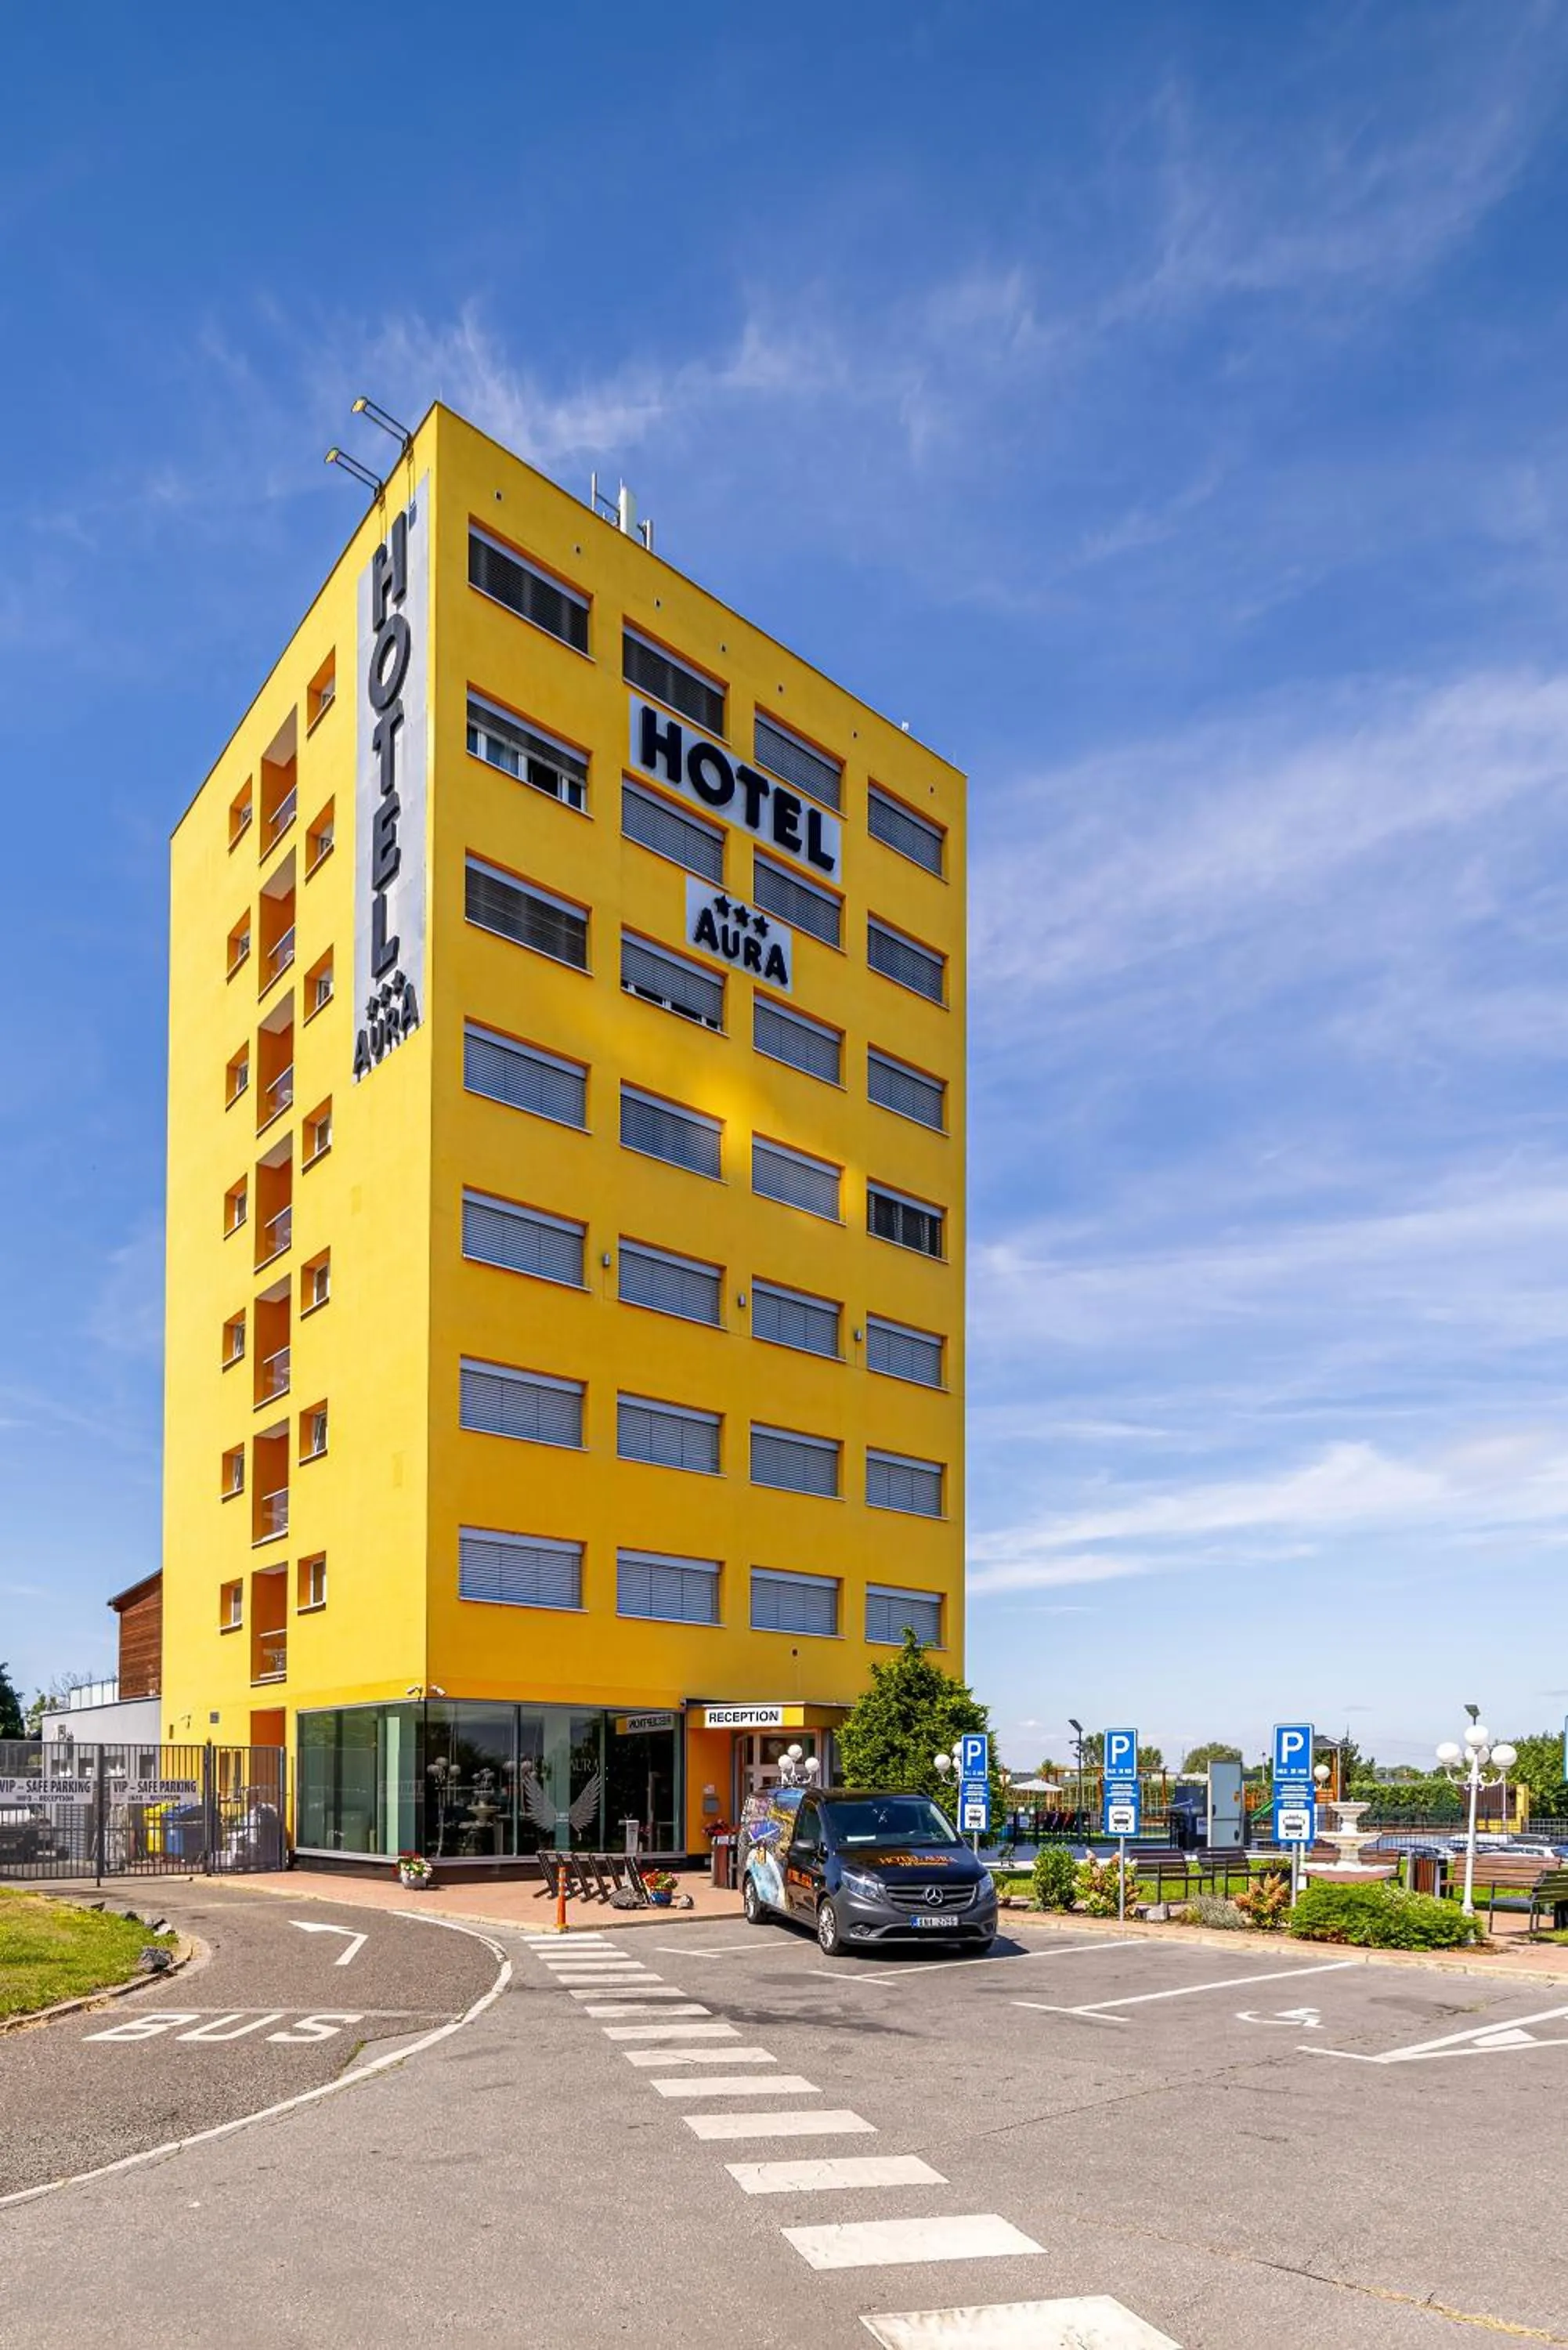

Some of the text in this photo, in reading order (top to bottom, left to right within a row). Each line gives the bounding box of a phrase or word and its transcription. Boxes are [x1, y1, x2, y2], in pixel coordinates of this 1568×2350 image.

[368, 510, 411, 984] HOTEL
[641, 706, 835, 872] HOTEL
[694, 907, 789, 985] AURA
[352, 983, 419, 1078] AURA
[709, 1710, 779, 1723] RECEPTION
[966, 1741, 982, 1766] P
[1111, 1735, 1129, 1765] P
[1281, 1732, 1304, 1763] P
[0, 1780, 16, 1792] VIP
[26, 1780, 48, 1792] SAFE
[50, 1781, 91, 1793] PARKING
[113, 1781, 128, 1792] VIP
[137, 1781, 157, 1792] SAFE
[159, 1781, 196, 1792] PARKING
[81, 2014, 364, 2042] BUS
